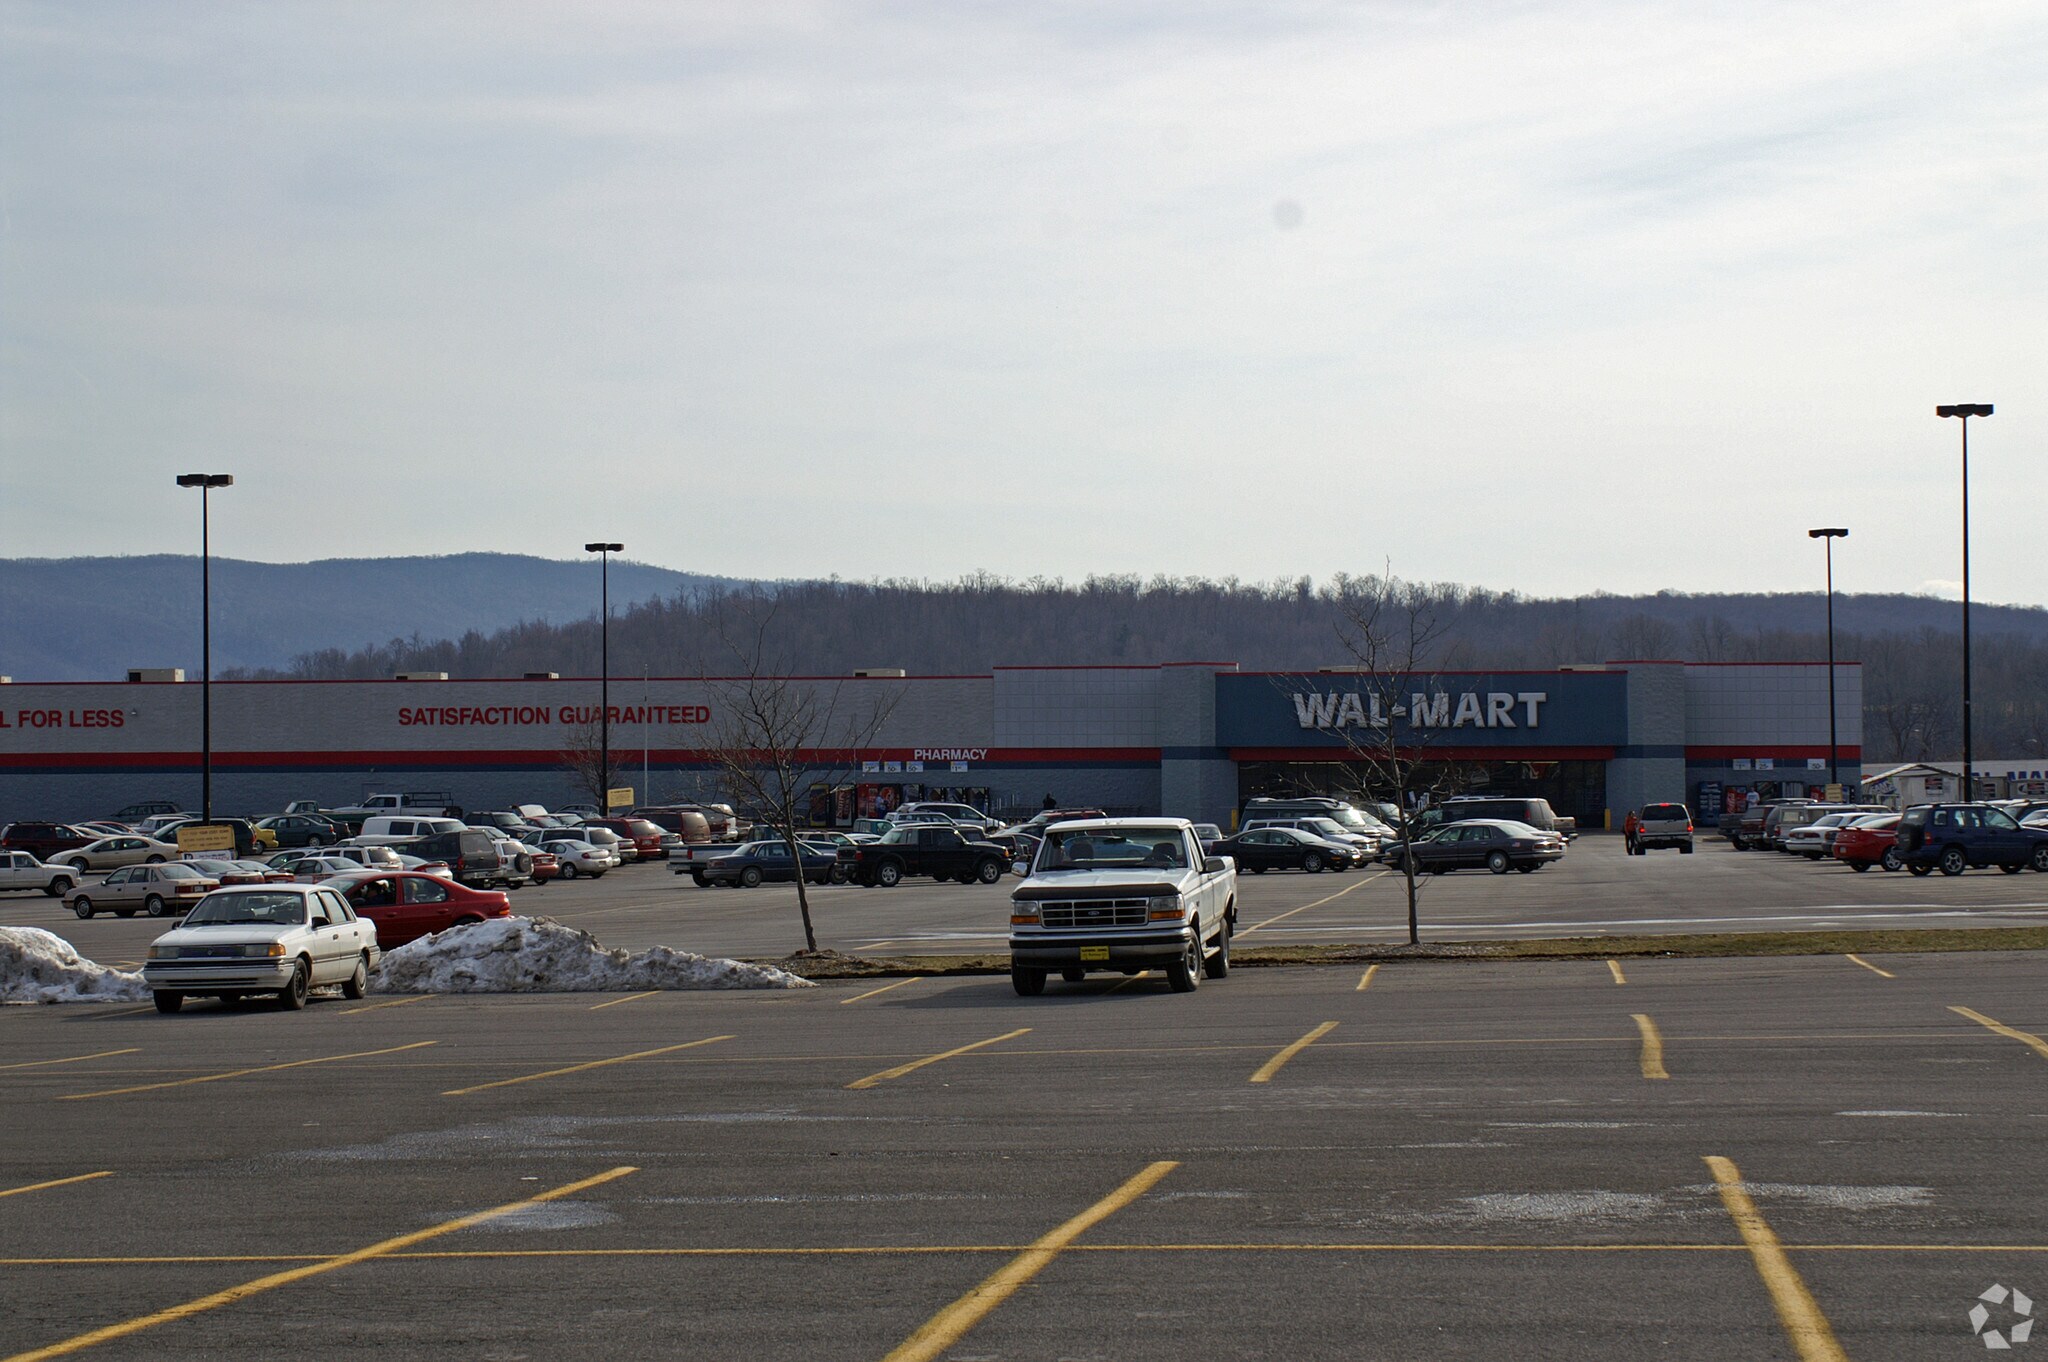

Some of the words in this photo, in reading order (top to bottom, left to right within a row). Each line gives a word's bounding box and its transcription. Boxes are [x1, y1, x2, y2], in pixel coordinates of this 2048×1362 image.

[18, 709, 62, 728] FOR
[69, 709, 124, 728] LESS
[398, 706, 550, 726] SATISFACTION
[558, 705, 711, 725] GUARANTEED
[1293, 692, 1547, 729] WAL-MART
[914, 748, 988, 760] PHARMACY
